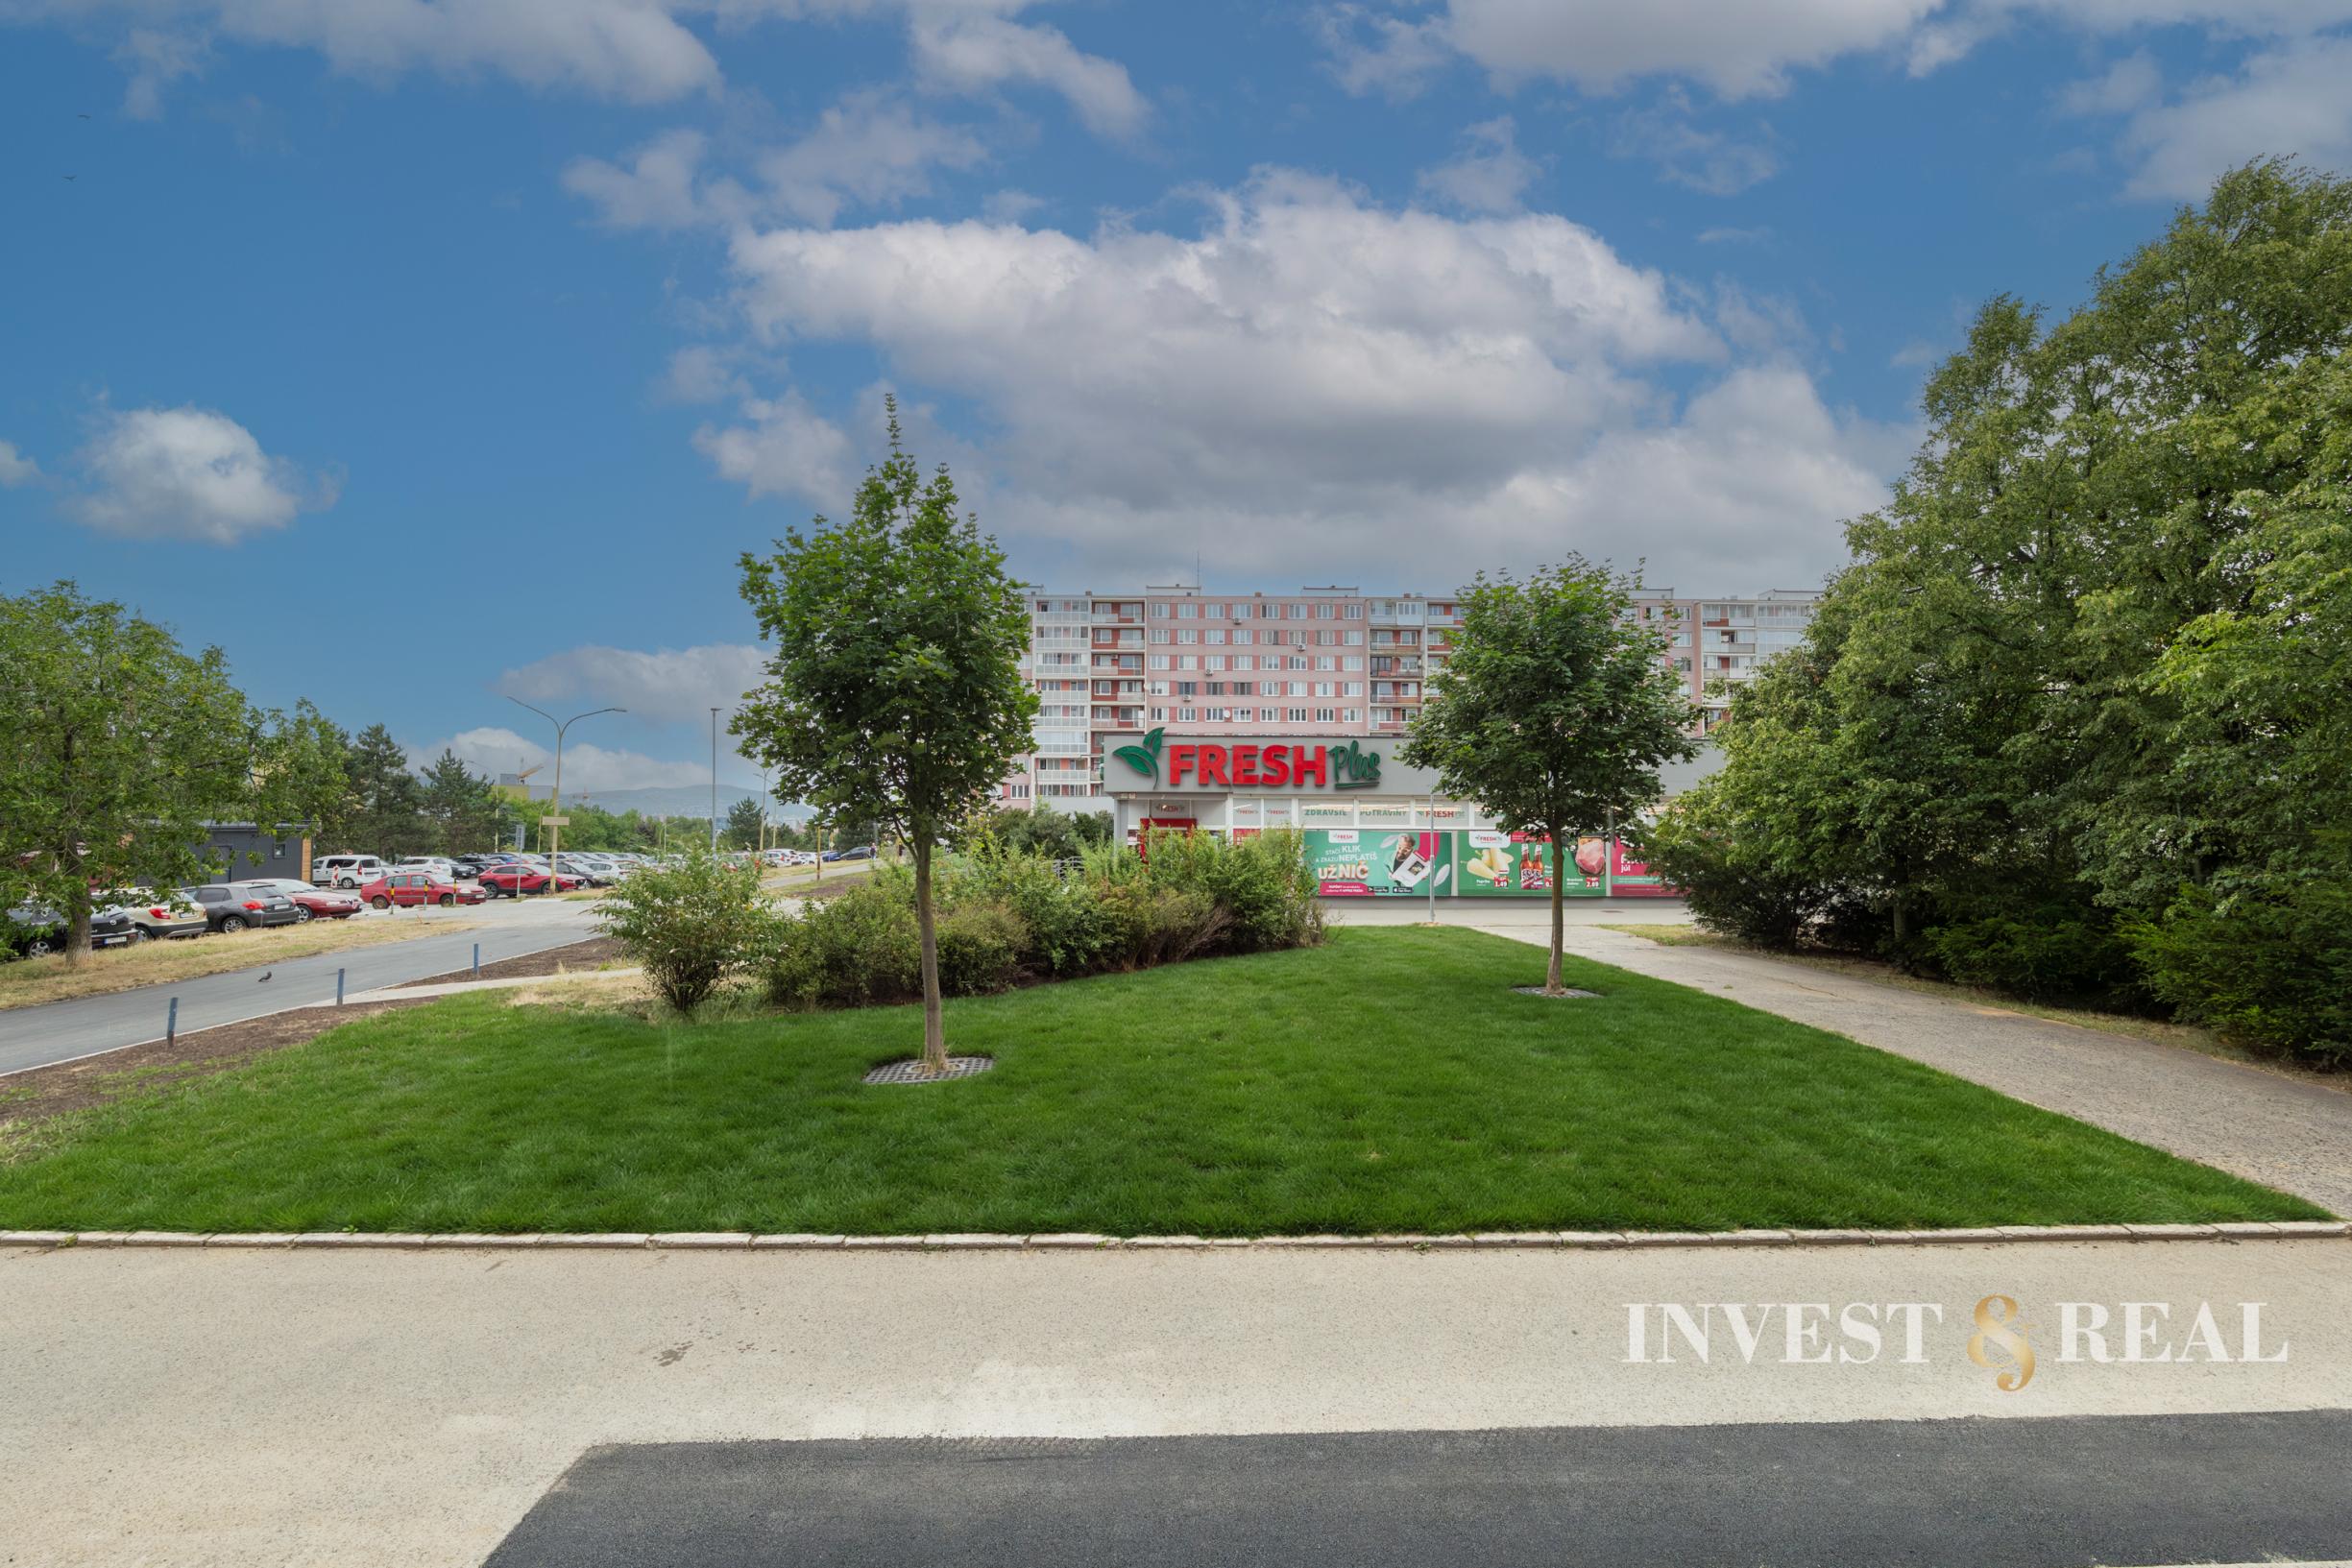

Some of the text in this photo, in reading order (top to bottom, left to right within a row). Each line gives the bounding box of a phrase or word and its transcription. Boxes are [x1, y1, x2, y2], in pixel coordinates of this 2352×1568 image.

[1169, 739, 1381, 785] FRESH Plus
[1342, 845, 1361, 854] KLIK
[1318, 860, 1369, 880] UŽ NIČ
